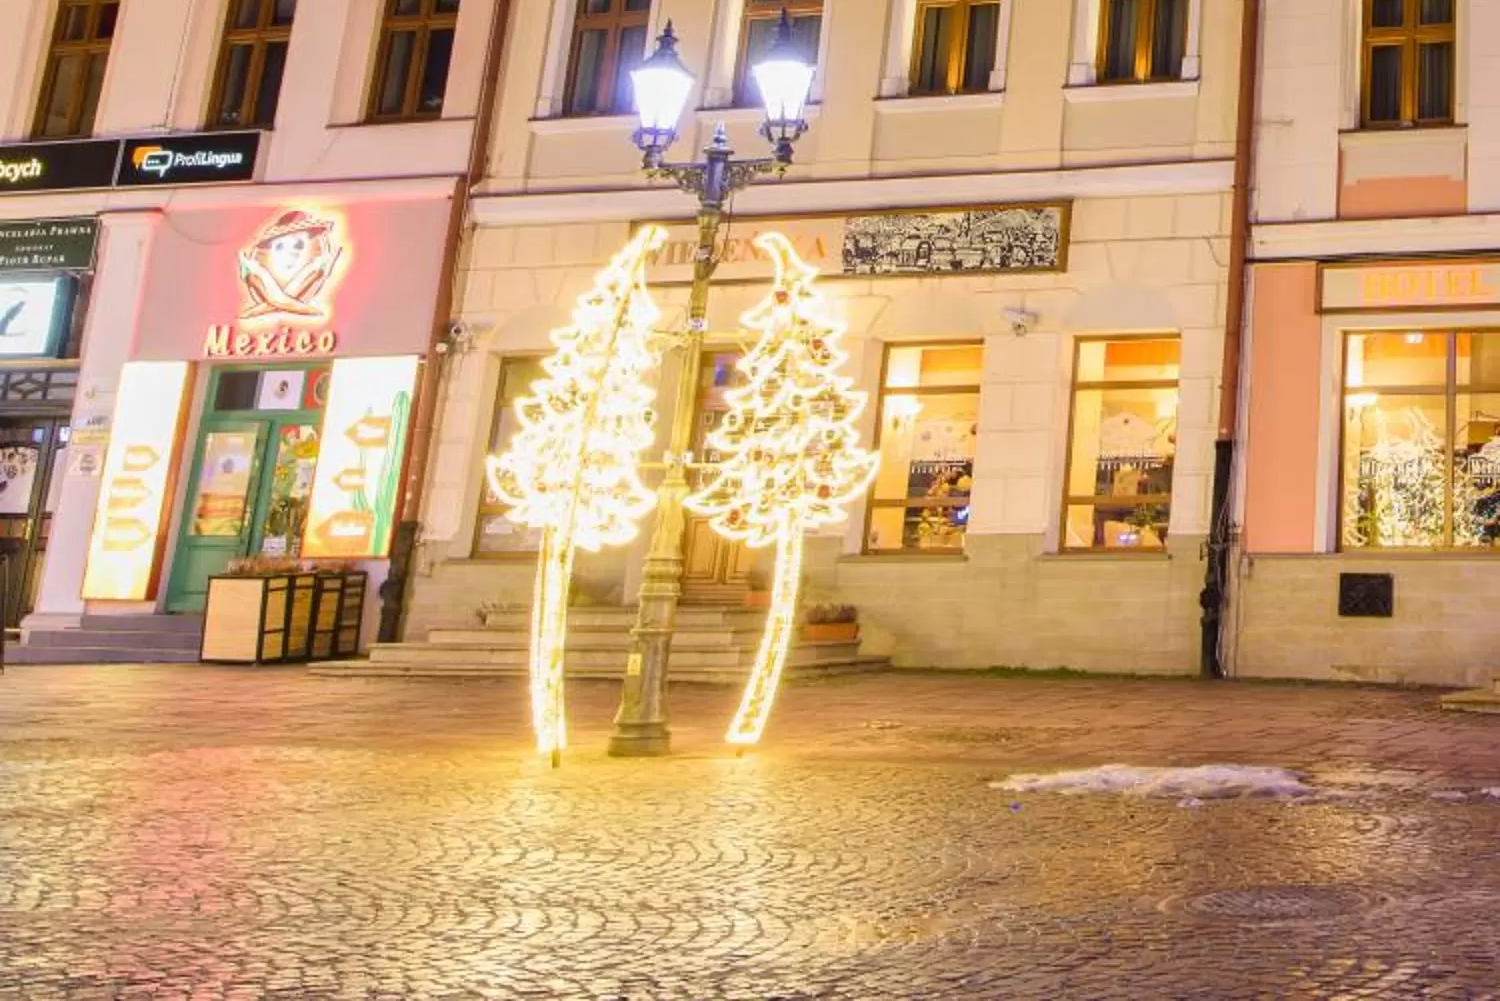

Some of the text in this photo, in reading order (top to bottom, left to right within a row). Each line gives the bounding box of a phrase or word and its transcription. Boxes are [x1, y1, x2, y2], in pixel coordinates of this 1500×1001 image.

[174, 150, 243, 168] ProfiLingua
[1361, 270, 1493, 299] HOTEL
[203, 324, 337, 358] Mexico
